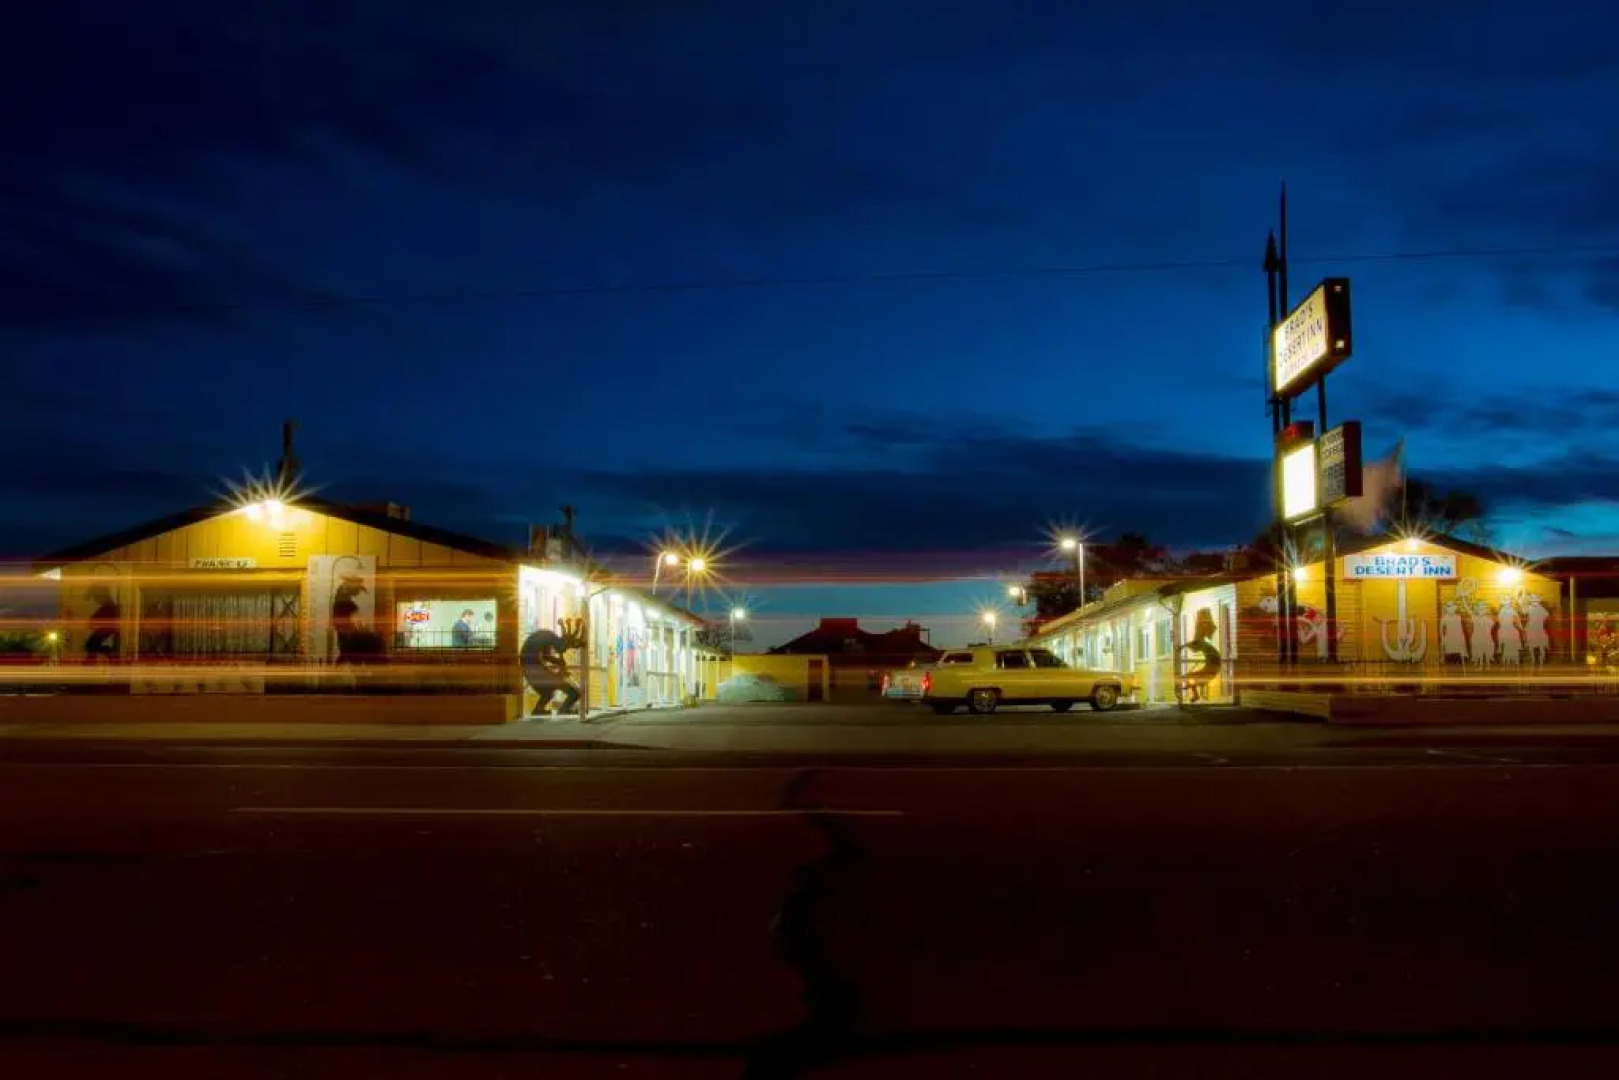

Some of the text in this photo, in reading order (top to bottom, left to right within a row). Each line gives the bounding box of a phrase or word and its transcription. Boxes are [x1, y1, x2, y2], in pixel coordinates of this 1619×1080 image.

[1279, 329, 1306, 366] DESERT
[1306, 315, 1322, 340] INN
[1355, 566, 1451, 575] DESERT INN
